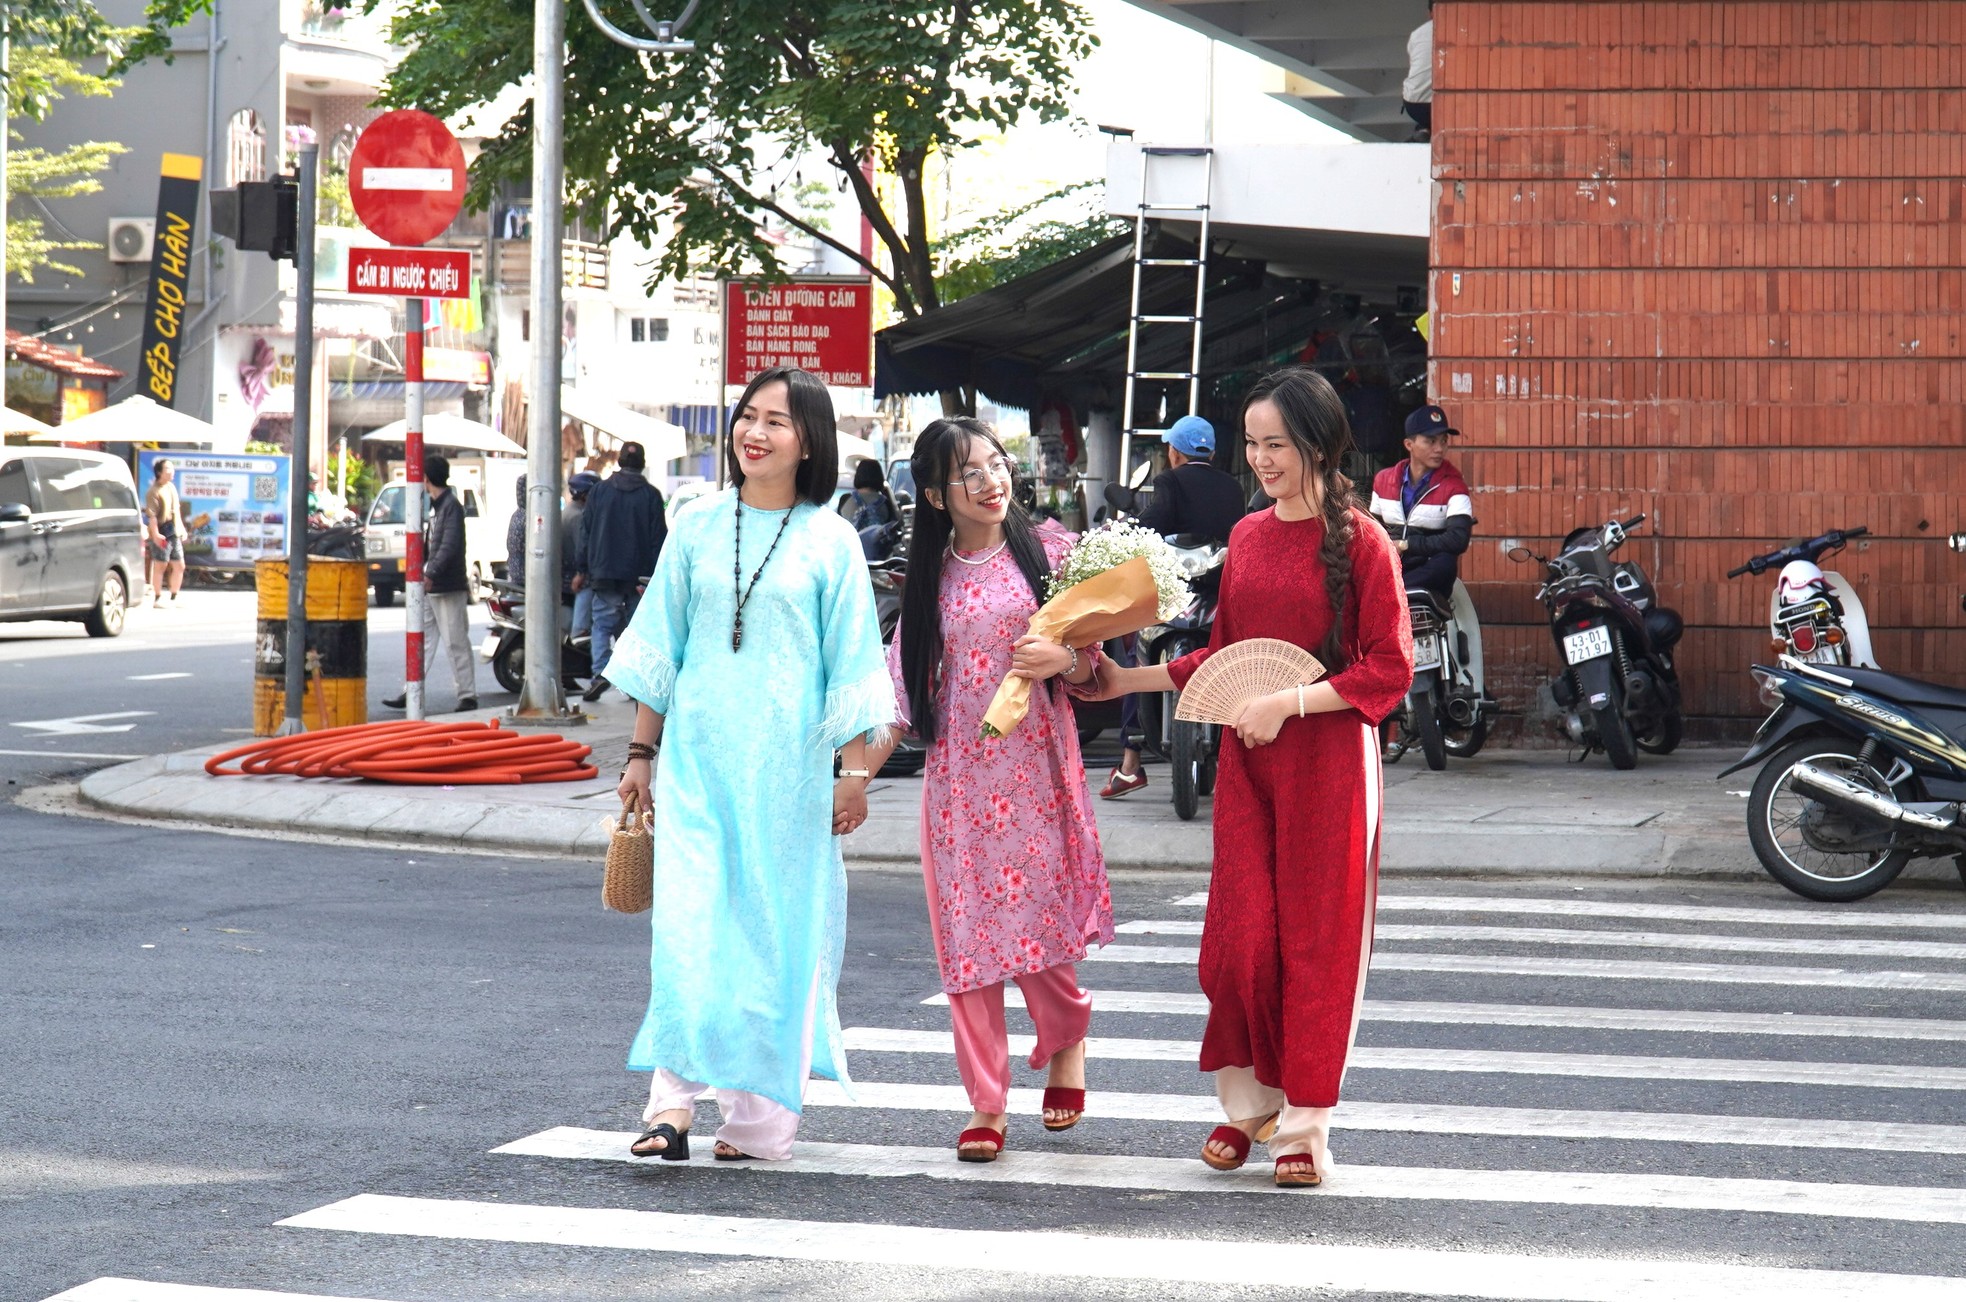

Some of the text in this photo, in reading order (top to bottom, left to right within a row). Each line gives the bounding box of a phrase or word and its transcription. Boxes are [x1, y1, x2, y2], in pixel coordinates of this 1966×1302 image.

[356, 258, 377, 287] CẤM
[379, 266, 390, 288] ĐI
[393, 262, 425, 293] NGƯỢC
[785, 287, 825, 307] ĐƯỜNG
[829, 287, 856, 307] CẤM
[146, 211, 190, 401] BẾP CHỢ HÀN
[746, 307, 771, 322] ĐÁNH
[746, 322, 764, 337] BÁN
[767, 323, 790, 337] SÁCH
[792, 323, 810, 337] BÁO
[746, 338, 764, 352] BÁN
[767, 338, 790, 352] HÀNG
[746, 355, 757, 369] TỤ
[779, 356, 799, 367] MUA
[1791, 604, 1816, 615] HOND
[1570, 640, 1608, 663] 721.97
